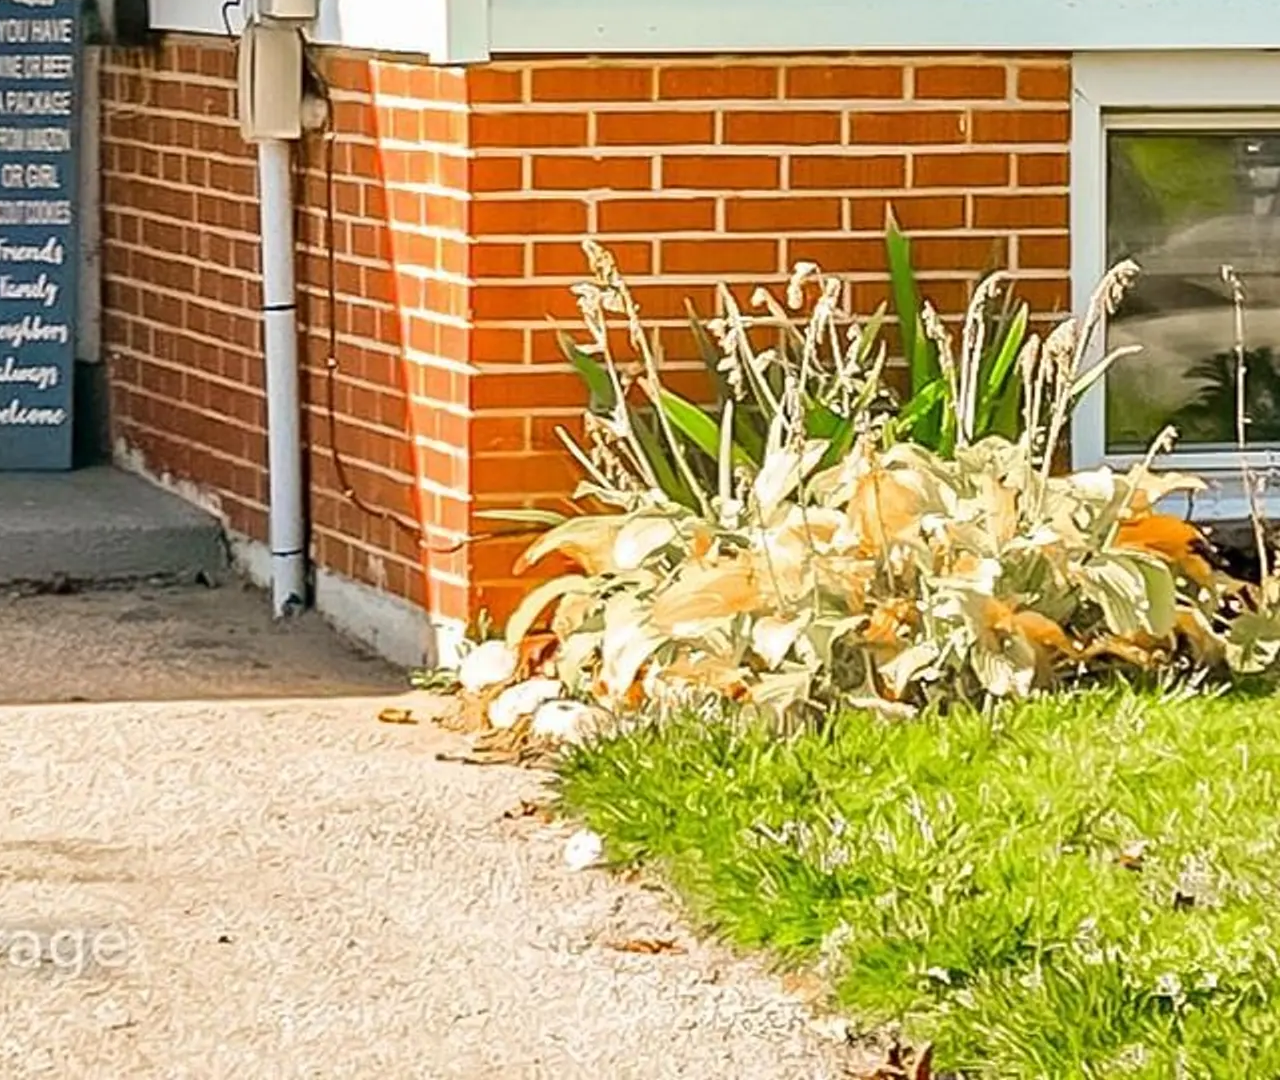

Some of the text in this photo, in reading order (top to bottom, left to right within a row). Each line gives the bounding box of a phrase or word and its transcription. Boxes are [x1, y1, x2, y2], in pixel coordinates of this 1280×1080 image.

[31, 18, 73, 43] HAVE
[6, 91, 72, 115] PACKAGE
[1, 163, 61, 188] OR GIRL
